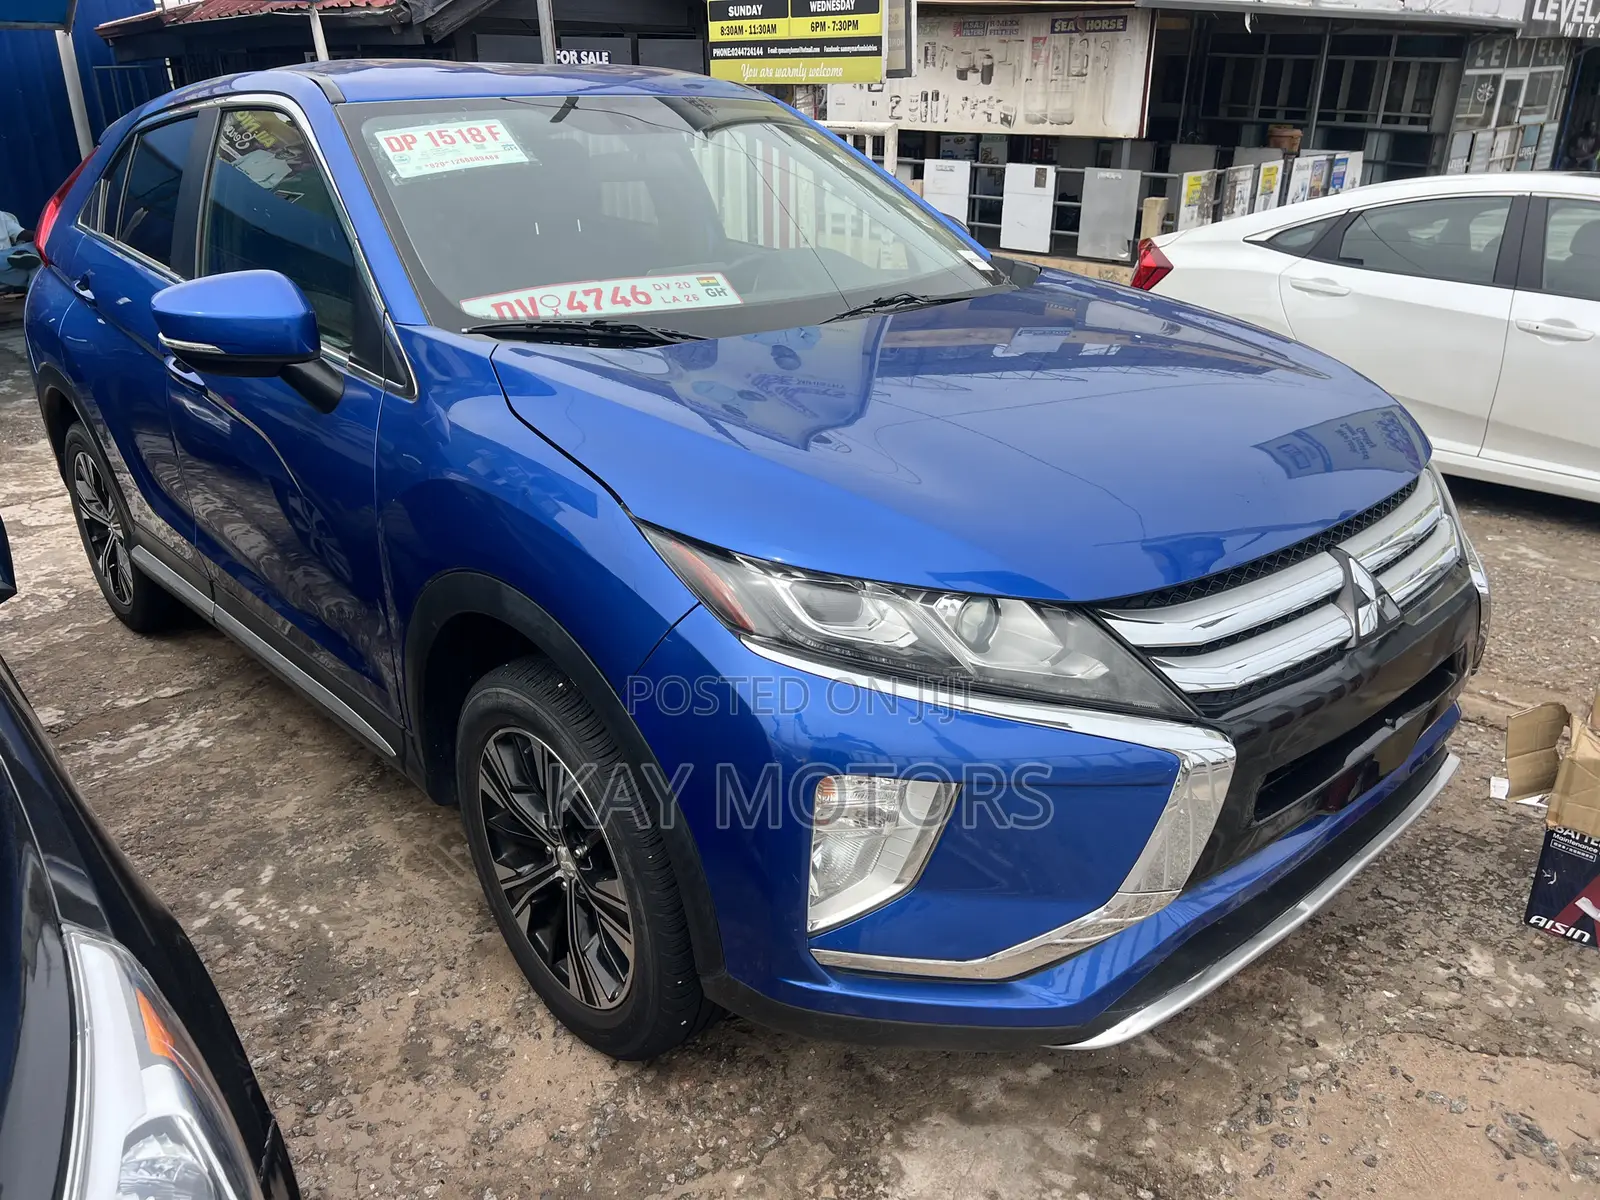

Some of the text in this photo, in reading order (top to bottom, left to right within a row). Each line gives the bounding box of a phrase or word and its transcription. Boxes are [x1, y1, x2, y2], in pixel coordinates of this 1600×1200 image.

[728, 4, 763, 17] SUNDAY
[810, 0, 856, 13] WEDNESDAY
[1532, 0, 1600, 34] LEVEL
[720, 24, 744, 36] 8:30AM
[749, 23, 777, 34] 11:30AM
[811, 21, 827, 33] 6PM
[832, 20, 859, 31] 7:30PM
[1054, 19, 1123, 31] SEA HORSE
[1564, 22, 1600, 38] WIG
[556, 50, 609, 64] FOR SALE
[741, 62, 843, 81] You are warmly welcome
[384, 133, 417, 153] DP
[652, 281, 691, 291] DV 20
[705, 287, 729, 298] GH
[490, 284, 653, 319] DV 4746
[661, 294, 680, 304] LA
[1552, 833, 1598, 853] Maintenance
[1555, 826, 1600, 848] BATTE
